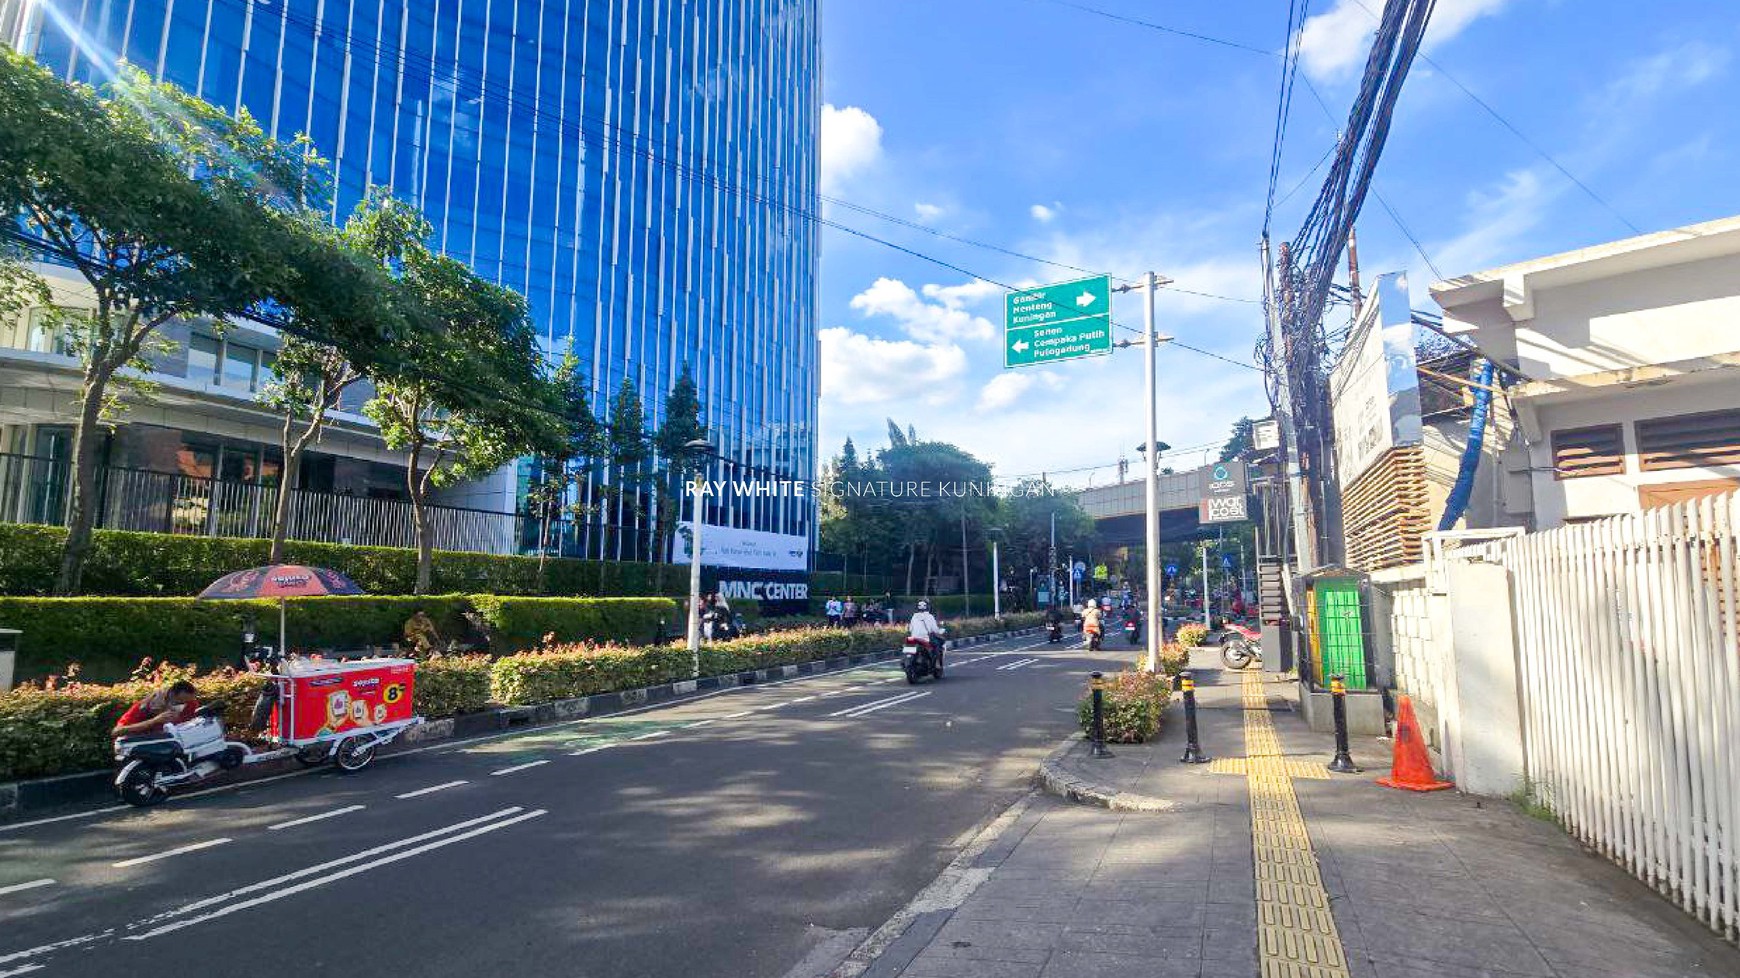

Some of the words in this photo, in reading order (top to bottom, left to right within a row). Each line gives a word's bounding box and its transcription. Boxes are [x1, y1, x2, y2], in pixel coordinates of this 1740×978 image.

[1013, 302, 1053, 314] Menteng
[1013, 311, 1056, 324] Kuningan
[1034, 327, 1063, 338] Senen
[1034, 335, 1077, 348] Cempaka
[1079, 330, 1105, 341] Putih
[1034, 344, 1090, 358] Pulogadung
[719, 580, 764, 600] MNC
[766, 582, 808, 600] CENTER
